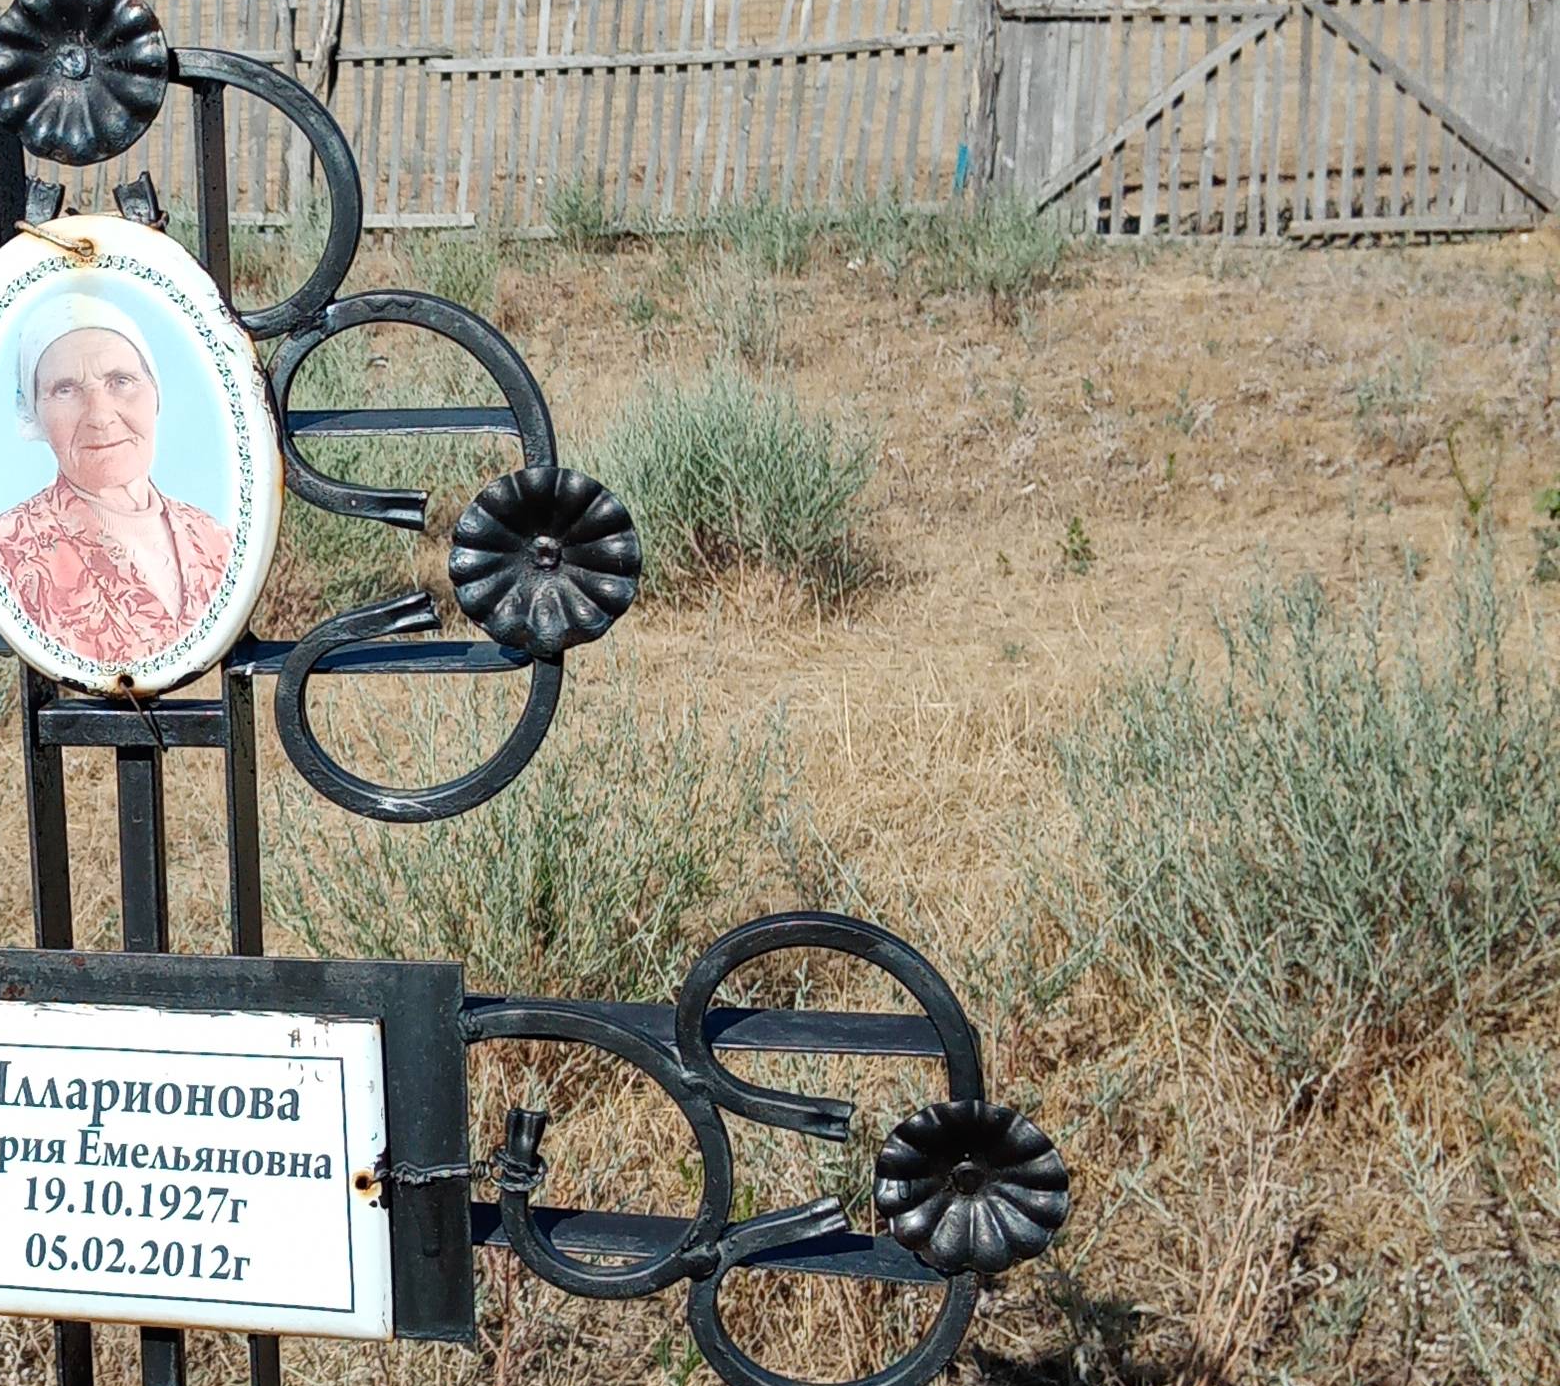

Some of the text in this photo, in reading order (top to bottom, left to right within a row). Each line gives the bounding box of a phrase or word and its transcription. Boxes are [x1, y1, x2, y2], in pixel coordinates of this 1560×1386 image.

[73, 1129, 333, 1180] Емельяновна
[23, 1176, 248, 1223] 19.10.1927г
[25, 1233, 251, 1281] 05.02.2012г
